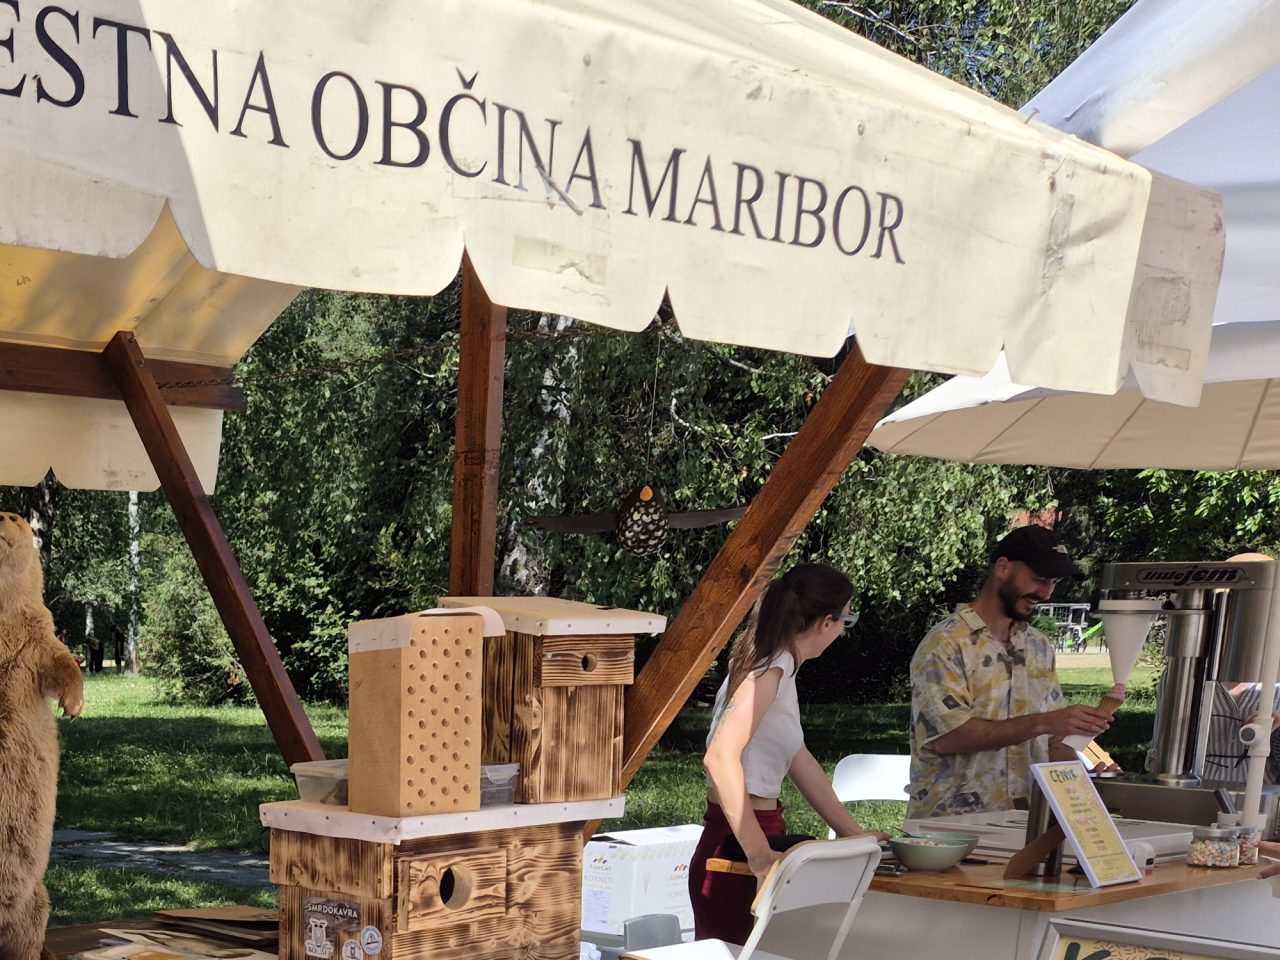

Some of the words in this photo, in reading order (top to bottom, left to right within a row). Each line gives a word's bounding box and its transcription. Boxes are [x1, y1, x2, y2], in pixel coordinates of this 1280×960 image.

[310, 67, 608, 217] OBČINA
[622, 138, 907, 265] MARIBOR
[306, 902, 359, 919] SMRDOKAVRA
